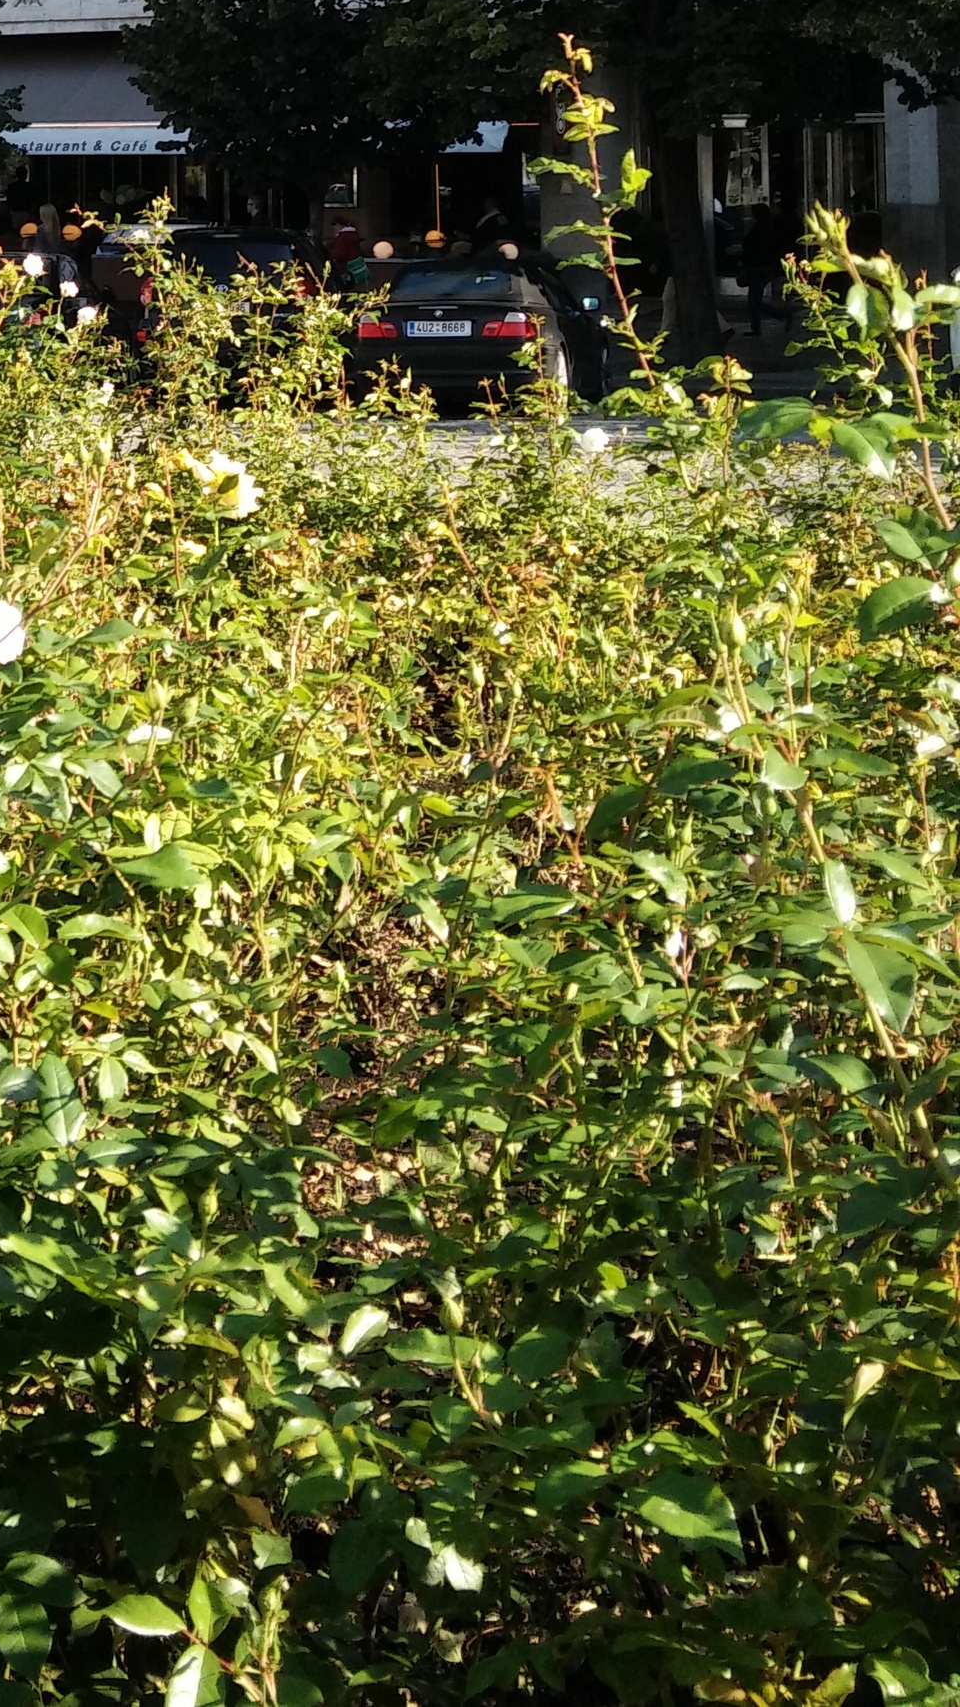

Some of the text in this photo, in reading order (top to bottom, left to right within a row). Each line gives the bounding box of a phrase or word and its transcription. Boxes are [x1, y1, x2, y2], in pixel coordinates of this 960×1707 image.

[19, 139, 149, 152] staurant & Café
